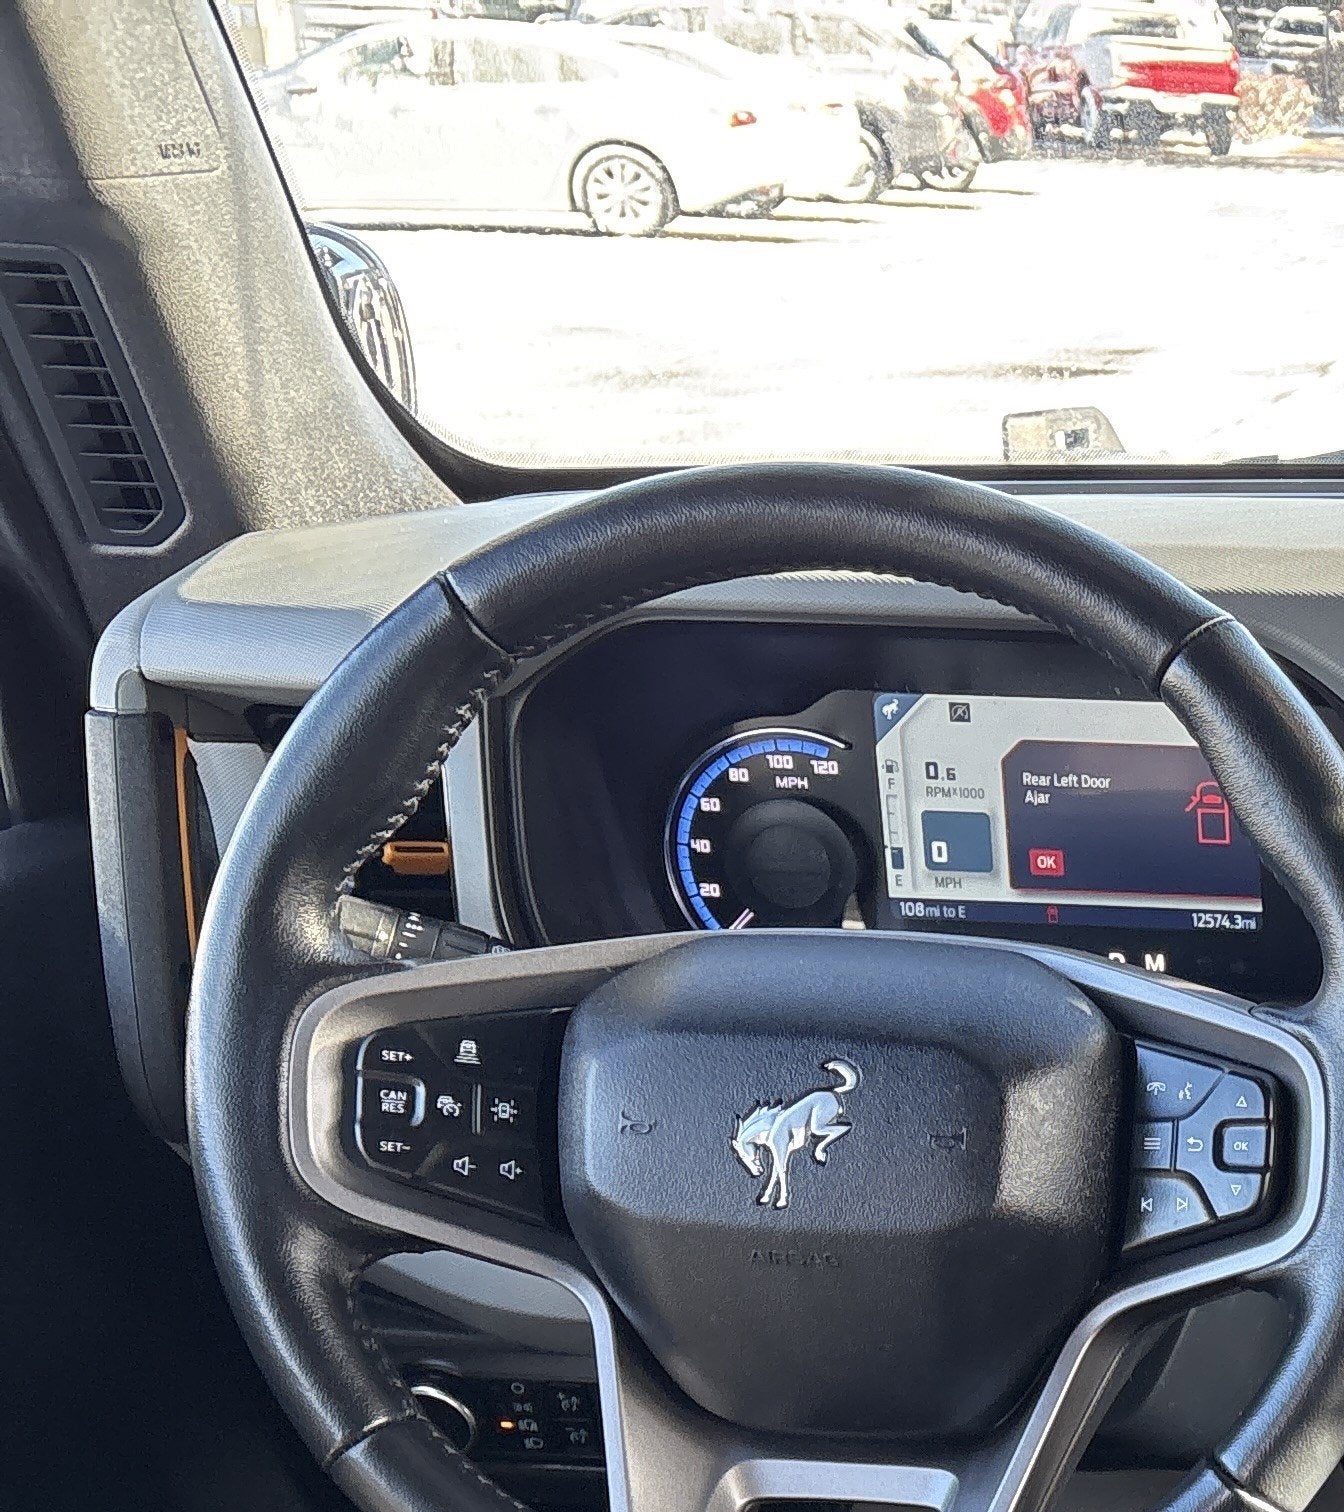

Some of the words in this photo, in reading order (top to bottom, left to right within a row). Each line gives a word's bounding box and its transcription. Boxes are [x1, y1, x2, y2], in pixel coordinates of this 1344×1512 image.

[765, 754, 794, 769] 100
[809, 760, 839, 775] 120
[728, 767, 749, 782] 80
[925, 761, 957, 781] 0.6
[775, 775, 809, 789] MPH
[1022, 772, 1051, 786] Rear
[1053, 773, 1080, 788] Left
[1081, 775, 1112, 789] Door
[700, 797, 721, 812] 60
[1024, 790, 1051, 806] Ajar
[690, 839, 711, 853] 40
[931, 840, 948, 863] 0
[1036, 855, 1057, 869] OK
[895, 874, 903, 886] E
[934, 876, 963, 889] MPH
[699, 883, 721, 898] 20
[943, 905, 956, 918] to
[958, 906, 966, 919] E
[1144, 953, 1165, 972] M
[381, 1049, 413, 1062] SET+
[379, 1089, 407, 1101] CAN
[381, 1102, 405, 1114] RES
[1233, 1141, 1249, 1151] OK
